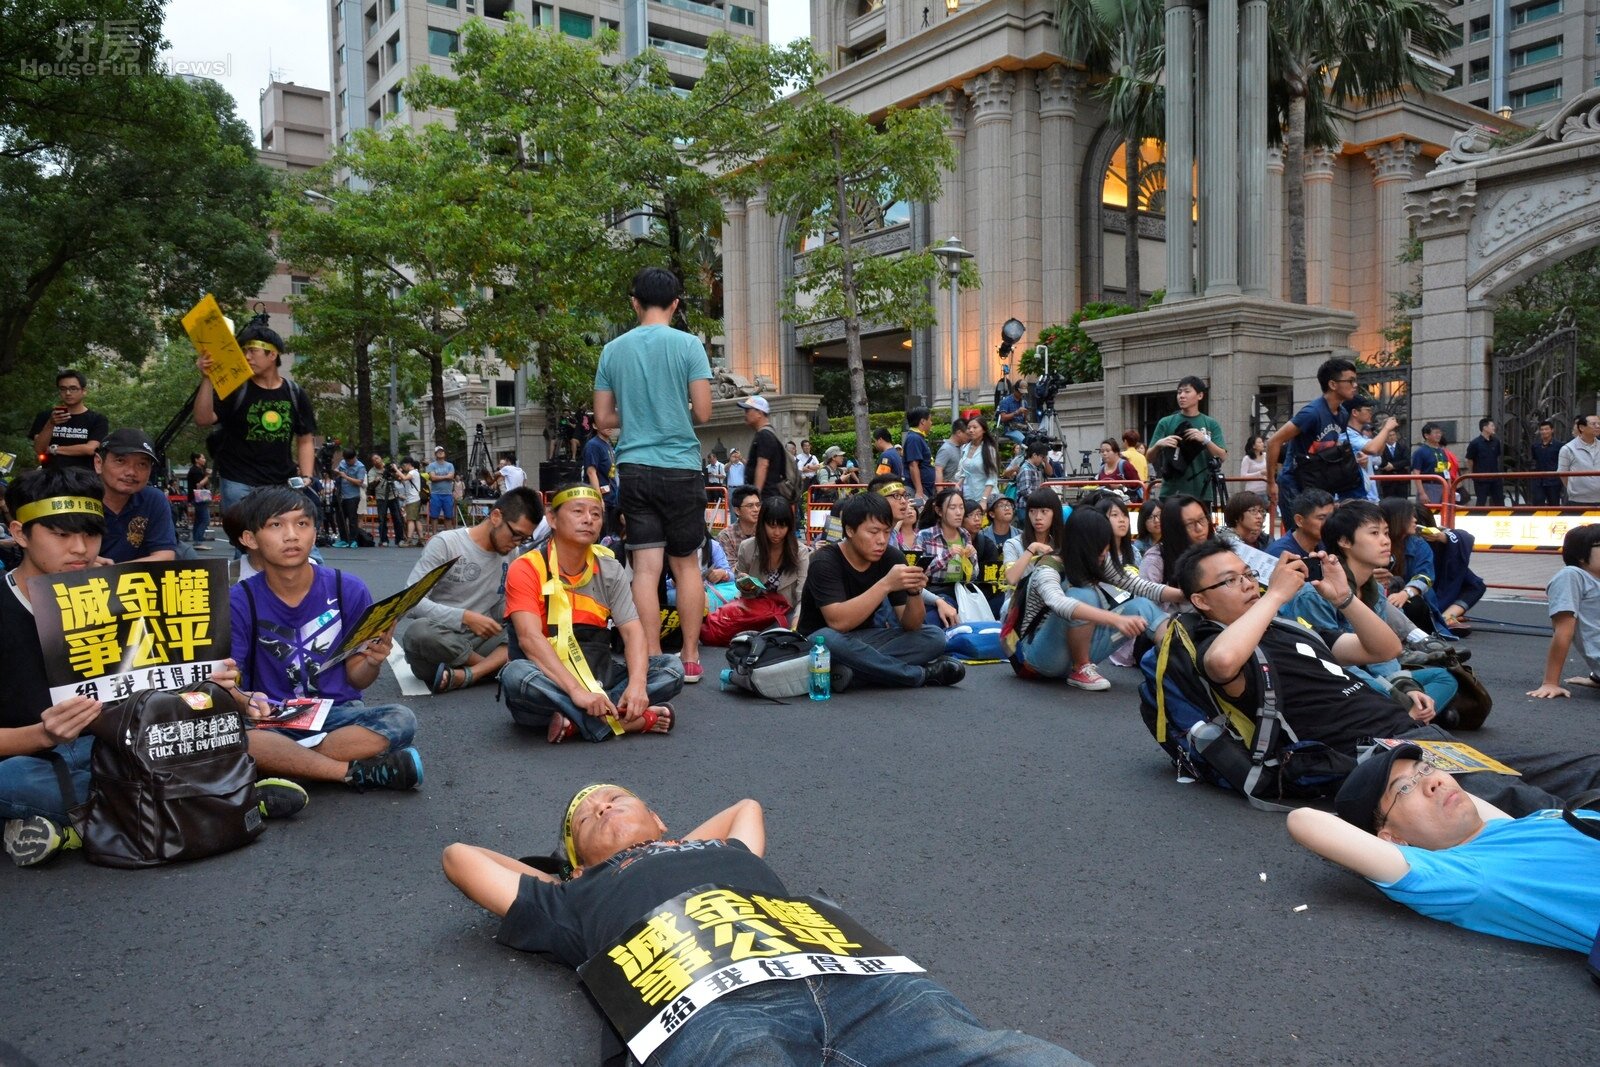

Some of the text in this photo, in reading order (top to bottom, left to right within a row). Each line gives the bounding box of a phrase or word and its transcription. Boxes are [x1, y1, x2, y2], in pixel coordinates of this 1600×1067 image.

[1494, 521, 1590, 539] 禁止停
[52, 568, 211, 632] 滅金權
[64, 615, 213, 678] 爭公平
[74, 663, 213, 701] 給我住得起
[145, 714, 240, 746] 自己國家自己救
[148, 744, 175, 761] FUCK
[177, 740, 195, 755] THE
[607, 889, 837, 976] 滅金權
[631, 919, 863, 1007] 爭公平
[659, 953, 896, 1035] 給我住得起
